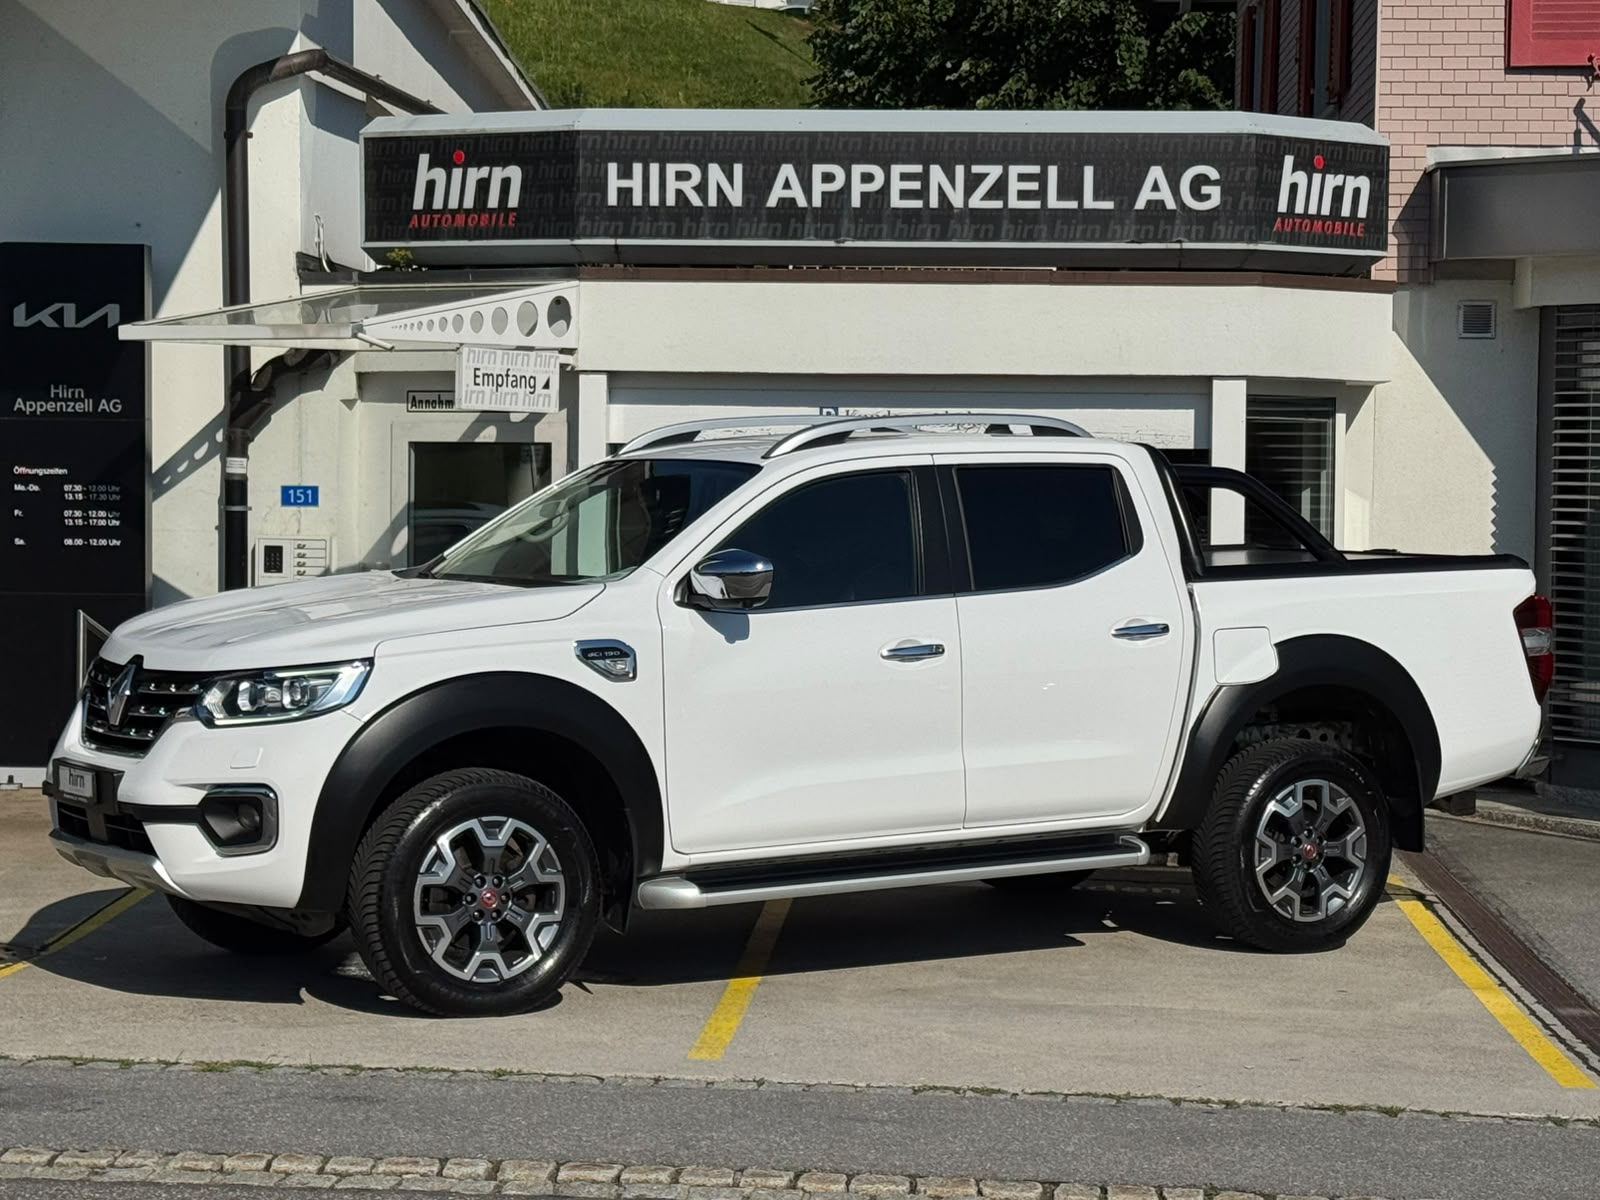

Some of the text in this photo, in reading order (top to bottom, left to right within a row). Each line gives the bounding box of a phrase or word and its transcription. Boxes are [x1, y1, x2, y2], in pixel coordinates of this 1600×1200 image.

[412, 149, 523, 210] hirn
[607, 162, 1222, 211] HIRN APPENZELL AG
[1277, 154, 1371, 219] hirn
[409, 212, 517, 229] AUTOMOBILE
[1273, 216, 1366, 238] AUTOMOBILE
[13, 302, 120, 328] KIA
[473, 367, 537, 394] Empfang
[50, 384, 84, 398] Hirn
[13, 398, 122, 415] Appenzell AG
[410, 394, 455, 410] Annahm
[13, 465, 68, 476] Öffnungszeiten
[63, 484, 82, 492] 07.30
[288, 489, 312, 503] 151
[64, 518, 83, 526] 13.15
[108, 510, 120, 518] Uhr
